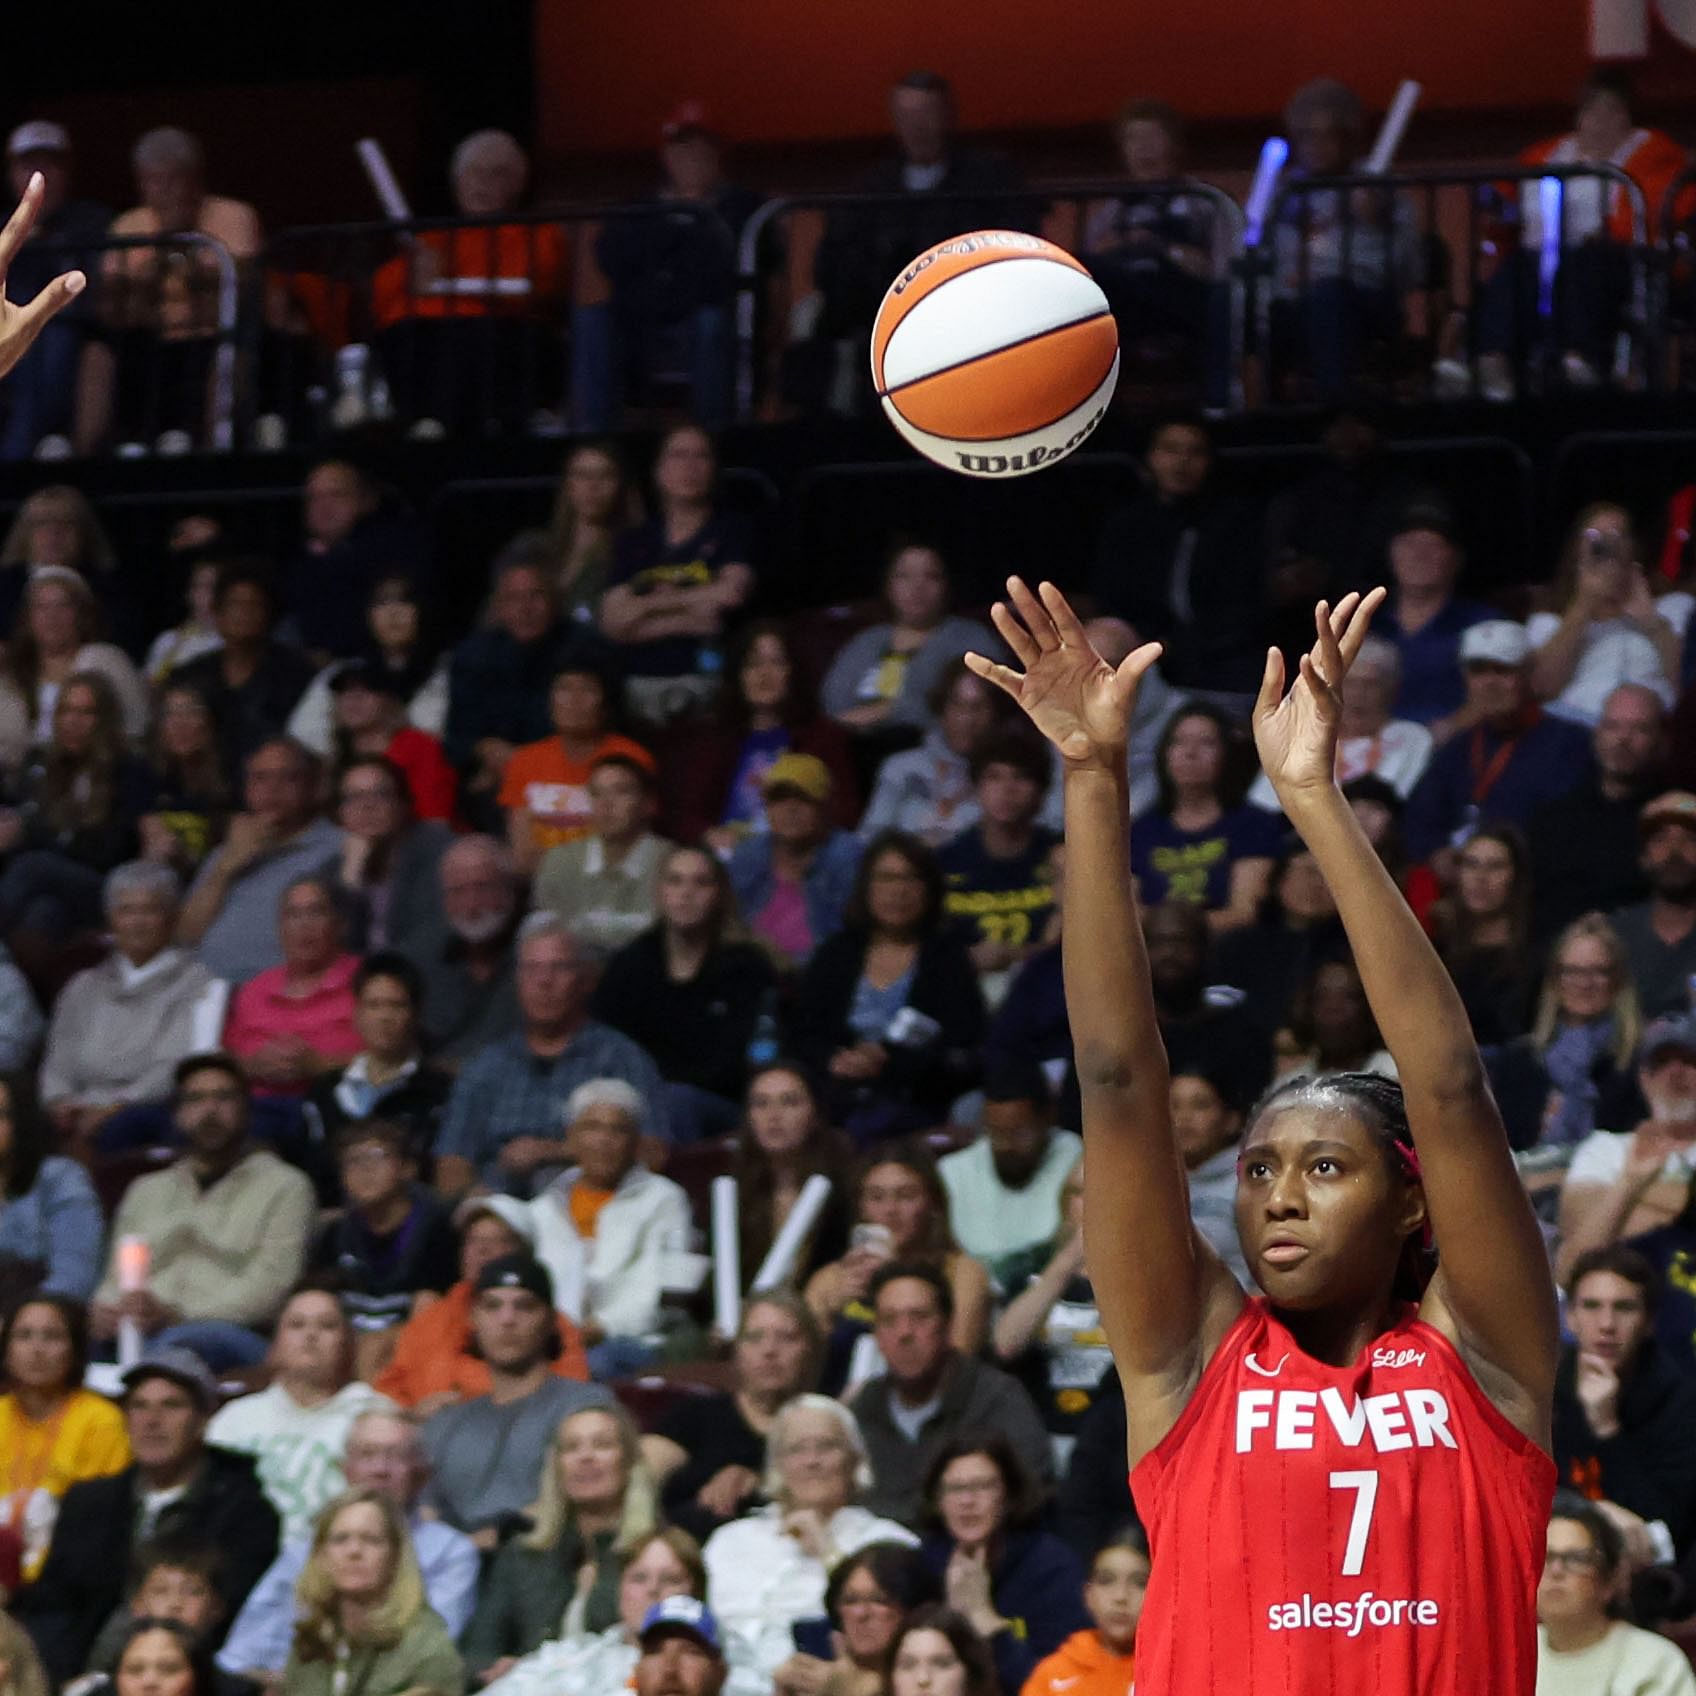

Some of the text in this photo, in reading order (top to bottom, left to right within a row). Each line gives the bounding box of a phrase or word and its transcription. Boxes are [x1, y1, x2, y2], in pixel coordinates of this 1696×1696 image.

[956, 407, 1105, 474] Wilson
[1372, 1347, 1426, 1369] Lilly
[1235, 1386, 1459, 1454] FEVER
[1329, 1469, 1379, 1576] 7
[1268, 1591, 1438, 1637] salesforce
